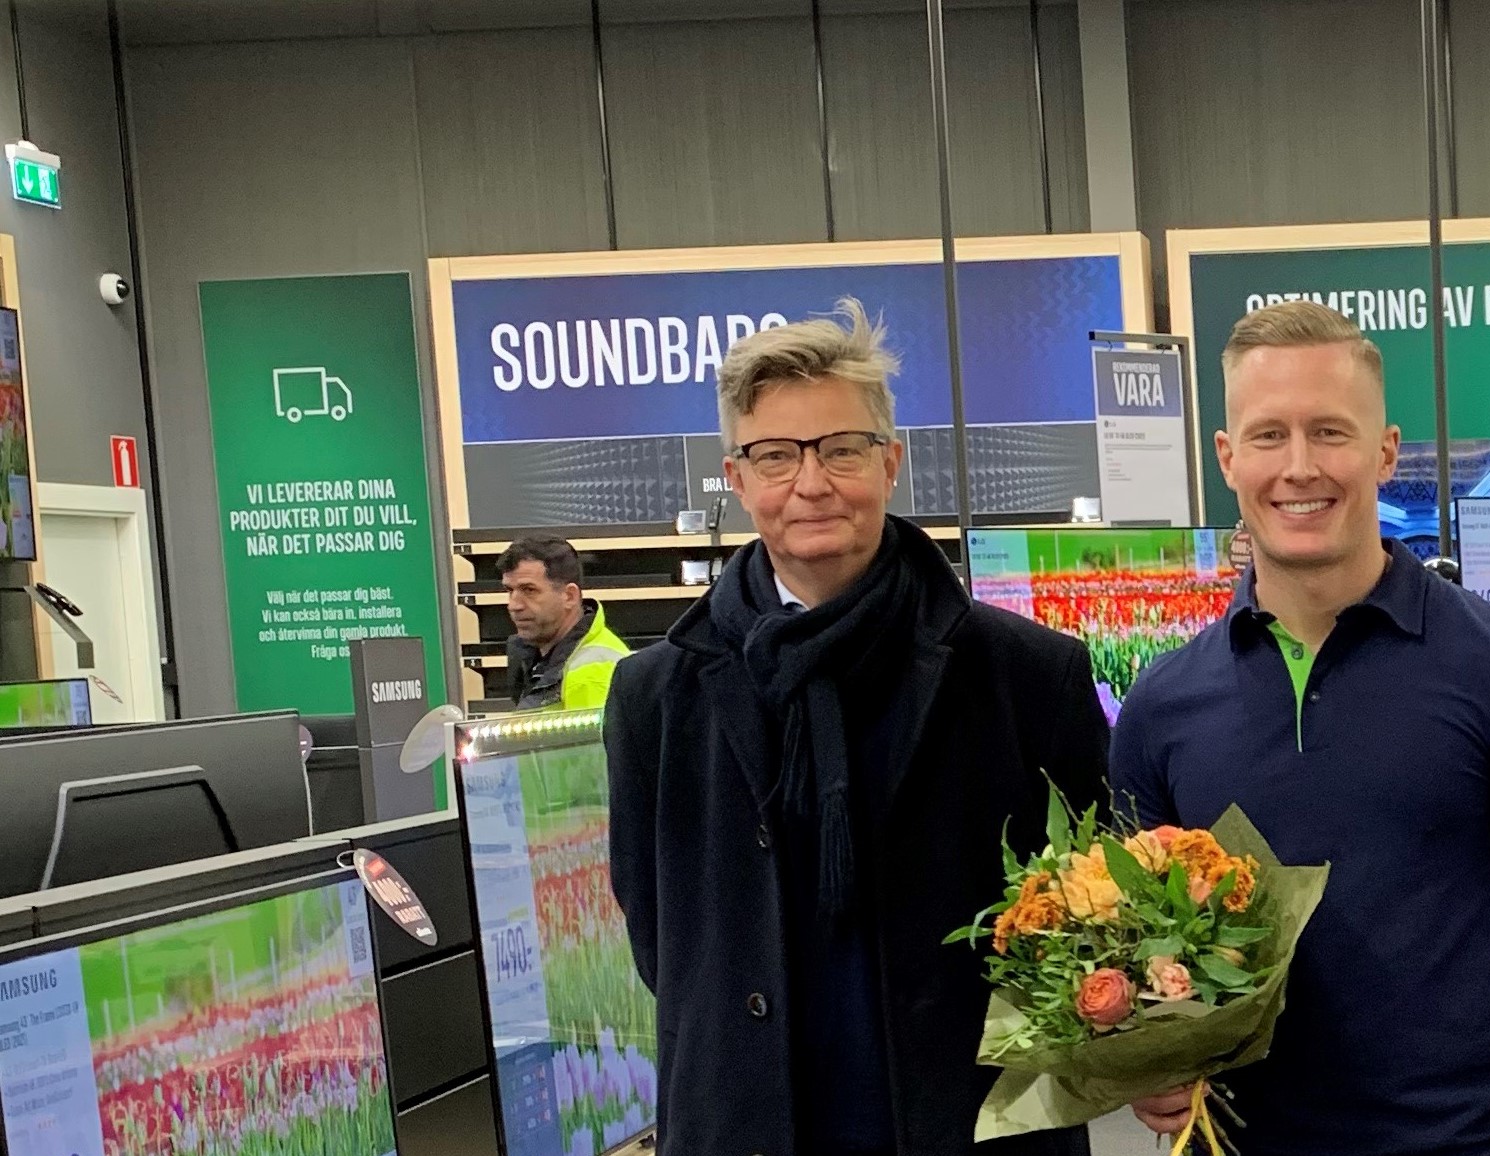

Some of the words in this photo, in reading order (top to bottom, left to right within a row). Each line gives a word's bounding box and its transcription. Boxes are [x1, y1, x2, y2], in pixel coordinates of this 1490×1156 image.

[1443, 286, 1474, 327] AV
[491, 312, 788, 392] SOUNDBA
[1113, 373, 1165, 407] VARA
[247, 484, 262, 504] VI
[267, 481, 353, 503] LEVERERAR
[358, 479, 396, 499] DINA
[702, 477, 723, 492] BRA
[230, 509, 320, 531] PRODUKTER
[325, 506, 349, 527] DIT
[354, 506, 374, 526] DU
[379, 504, 417, 526] VILL,
[247, 533, 278, 556] NÄR
[283, 534, 310, 554] DET
[316, 531, 375, 553] PASSAR
[379, 530, 405, 551] DIG
[266, 590, 285, 605] Välj
[286, 591, 301, 603] när
[303, 590, 318, 603] det
[320, 589, 352, 605] passar
[354, 588, 369, 603] dig
[370, 587, 394, 600] bäst.
[262, 609, 272, 623] Vi
[273, 609, 291, 622] kan
[292, 608, 320, 622] också
[322, 607, 343, 621] bära
[358, 605, 402, 619] installera
[258, 628, 276, 642] och
[278, 627, 321, 641] återvinna
[323, 626, 338, 639] din
[340, 625, 368, 641] gamla
[310, 644, 337, 661] Fråga
[371, 679, 422, 703] SAMSUNG
[0, 968, 57, 1000] AMSUNG
